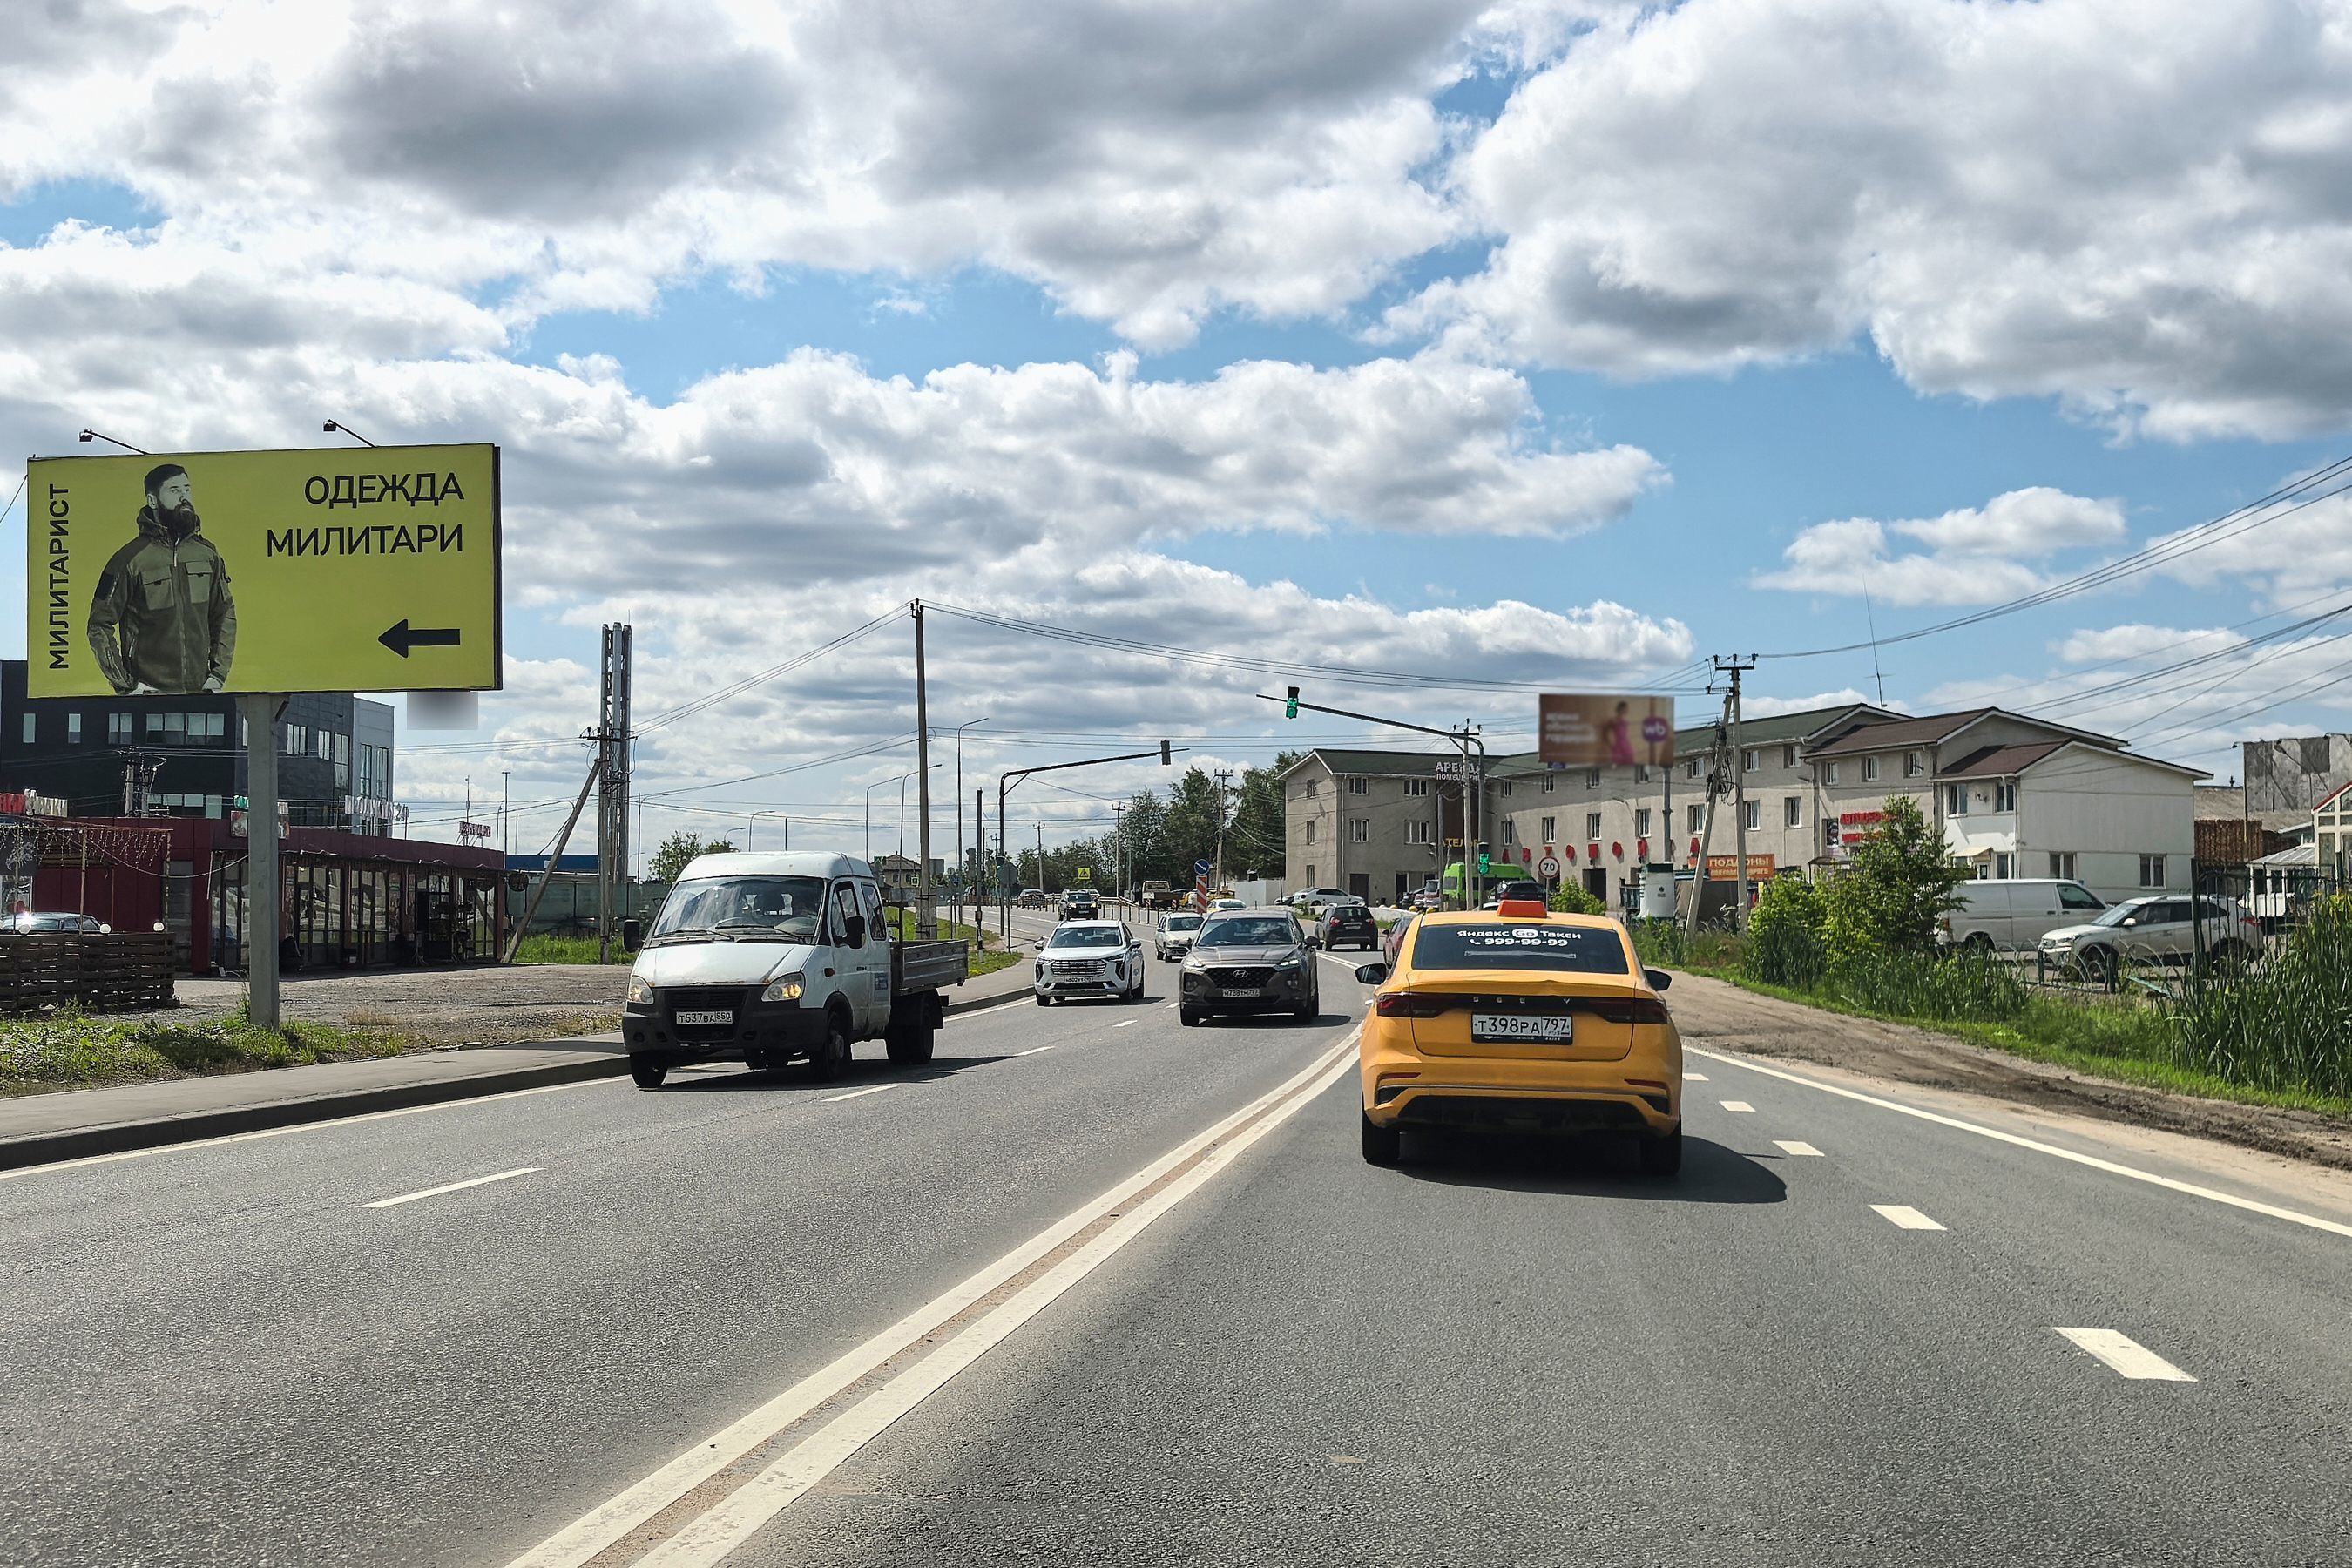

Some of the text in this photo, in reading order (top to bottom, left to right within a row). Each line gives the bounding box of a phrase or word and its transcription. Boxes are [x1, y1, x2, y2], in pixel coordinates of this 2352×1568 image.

[304, 472, 464, 509] ОДЕЖДА
[267, 524, 463, 557] МИЛИТАРИ
[49, 483, 70, 670] МИЛИТАРИСТ
[1544, 862, 1555, 871] 70
[1484, 938, 1568, 947] 999-99-99
[1539, 930, 1582, 939] Такси
[1477, 1017, 1540, 1034] Т398РА
[1543, 1017, 1568, 1031] 797
